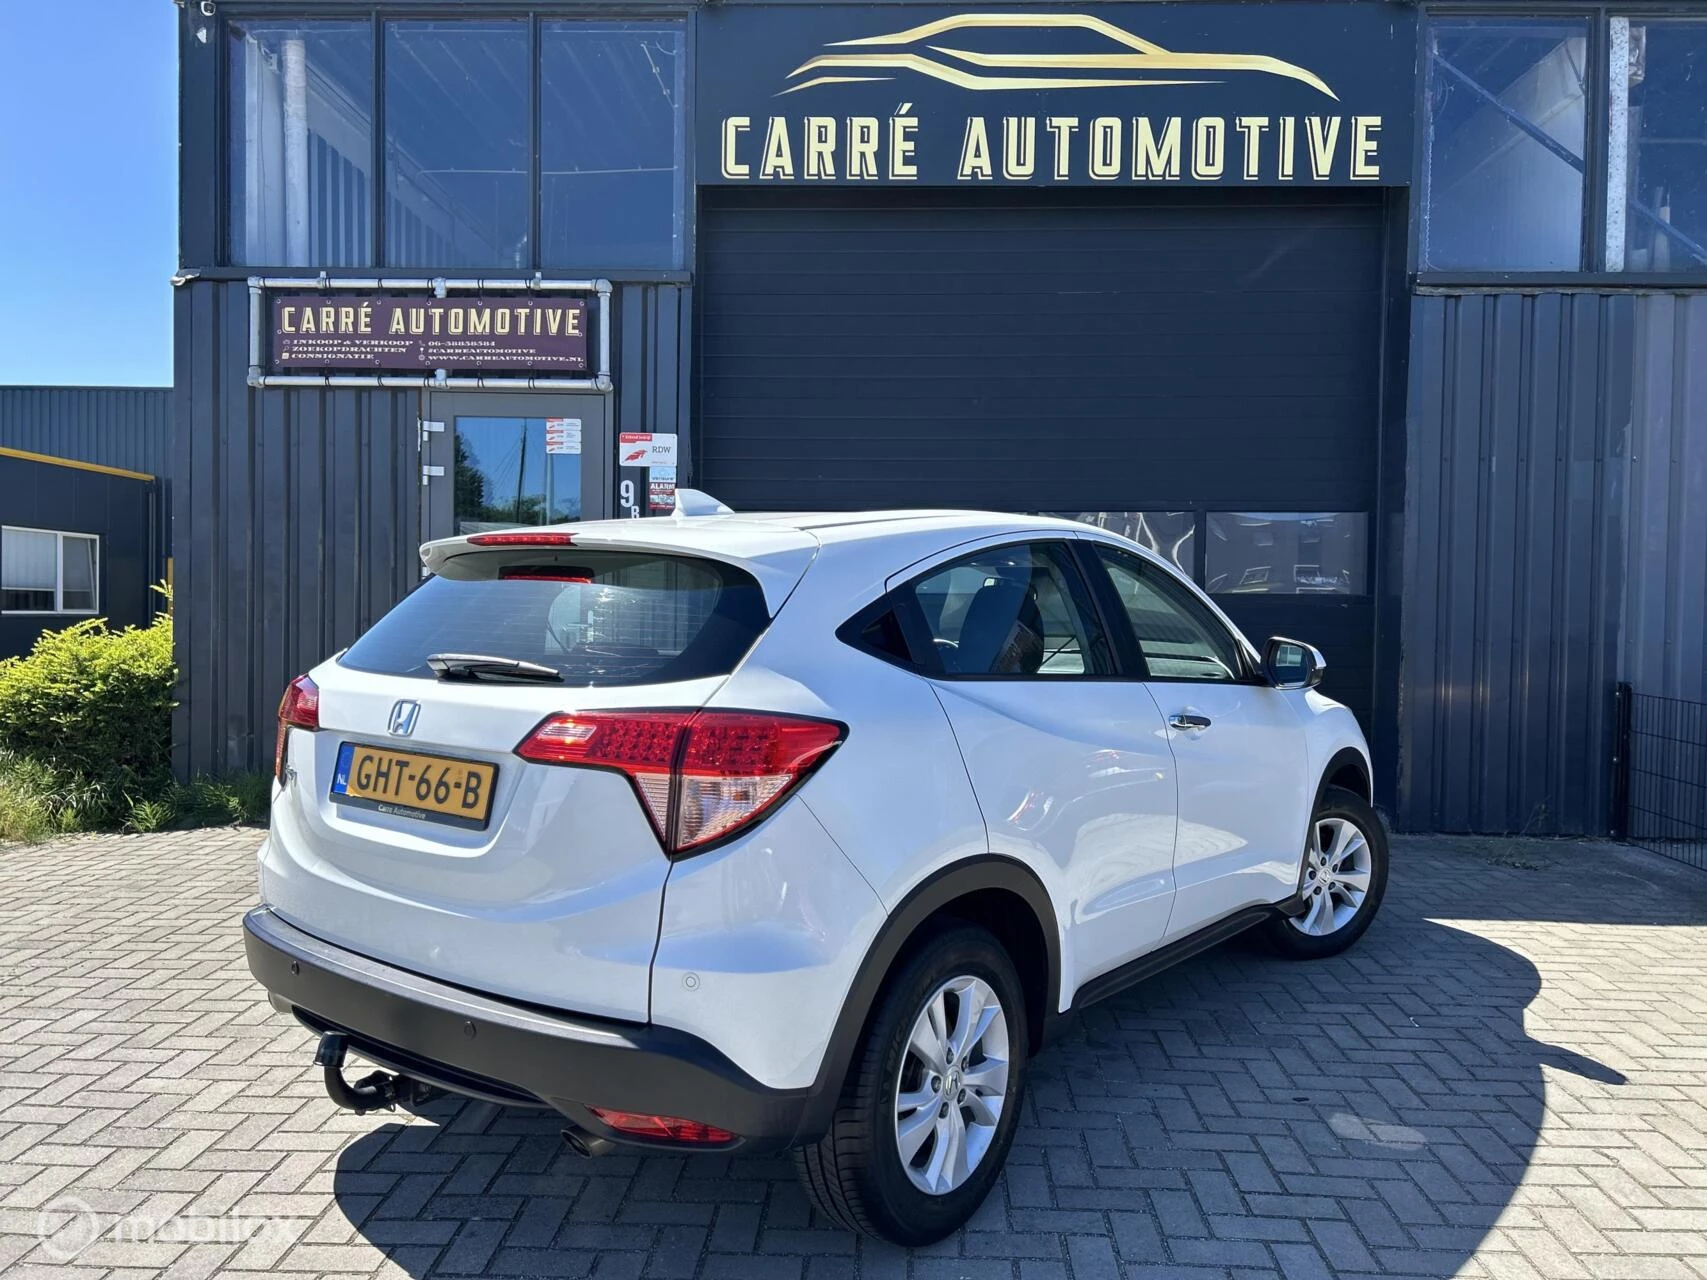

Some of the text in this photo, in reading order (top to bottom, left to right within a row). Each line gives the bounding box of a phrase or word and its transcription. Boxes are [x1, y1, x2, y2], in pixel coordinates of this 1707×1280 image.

[721, 102, 1382, 181] CARRÉ AUTOMOTIVE
[281, 301, 581, 336] CARRÉ AUTOMOTIVE
[652, 445, 672, 454] RDW
[620, 480, 634, 508] 9
[336, 773, 347, 786] NL
[356, 755, 482, 809] GHT-66-B
[393, 806, 426, 820] Automotive
